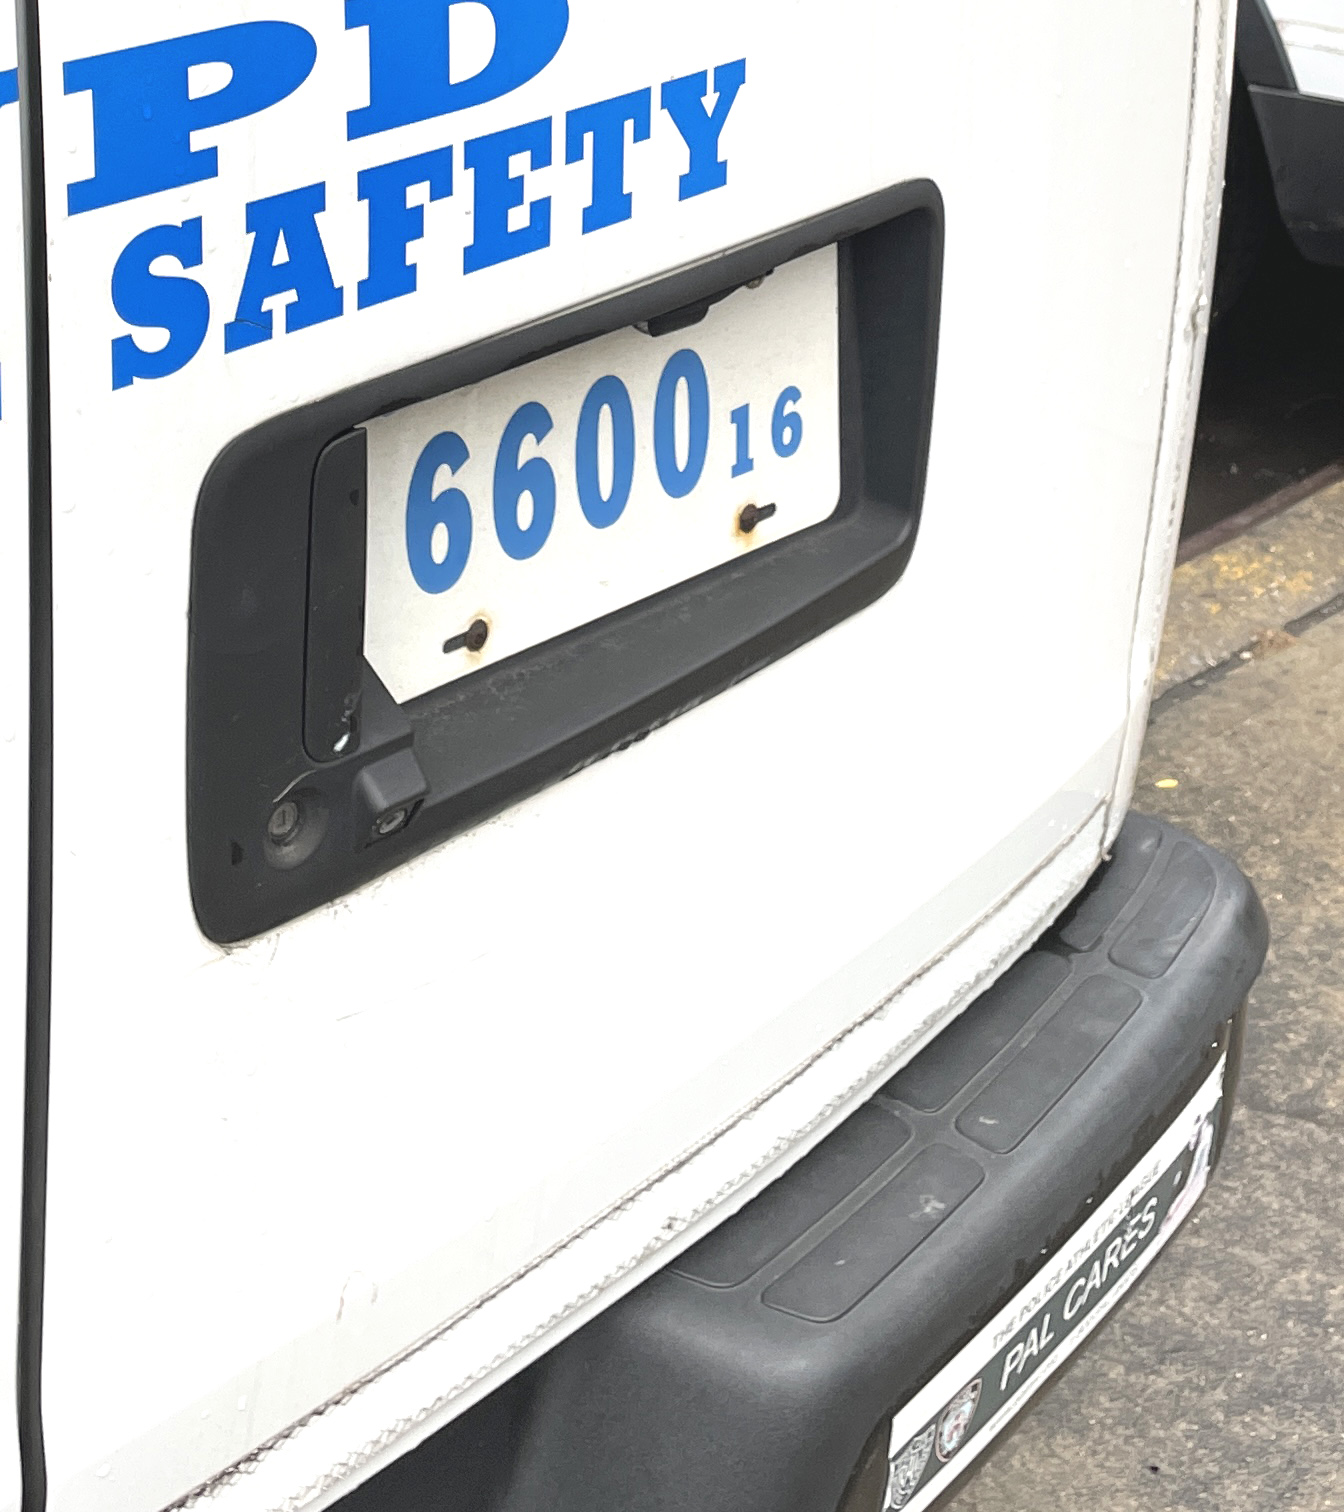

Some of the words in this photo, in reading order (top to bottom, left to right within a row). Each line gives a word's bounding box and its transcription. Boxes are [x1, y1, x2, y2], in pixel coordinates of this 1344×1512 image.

[111, 58, 746, 391] SAFETY
[405, 348, 711, 596] 6600
[729, 384, 804, 480] 16
[999, 1312, 1055, 1392] PAL
[1062, 1196, 1158, 1321] CARES
